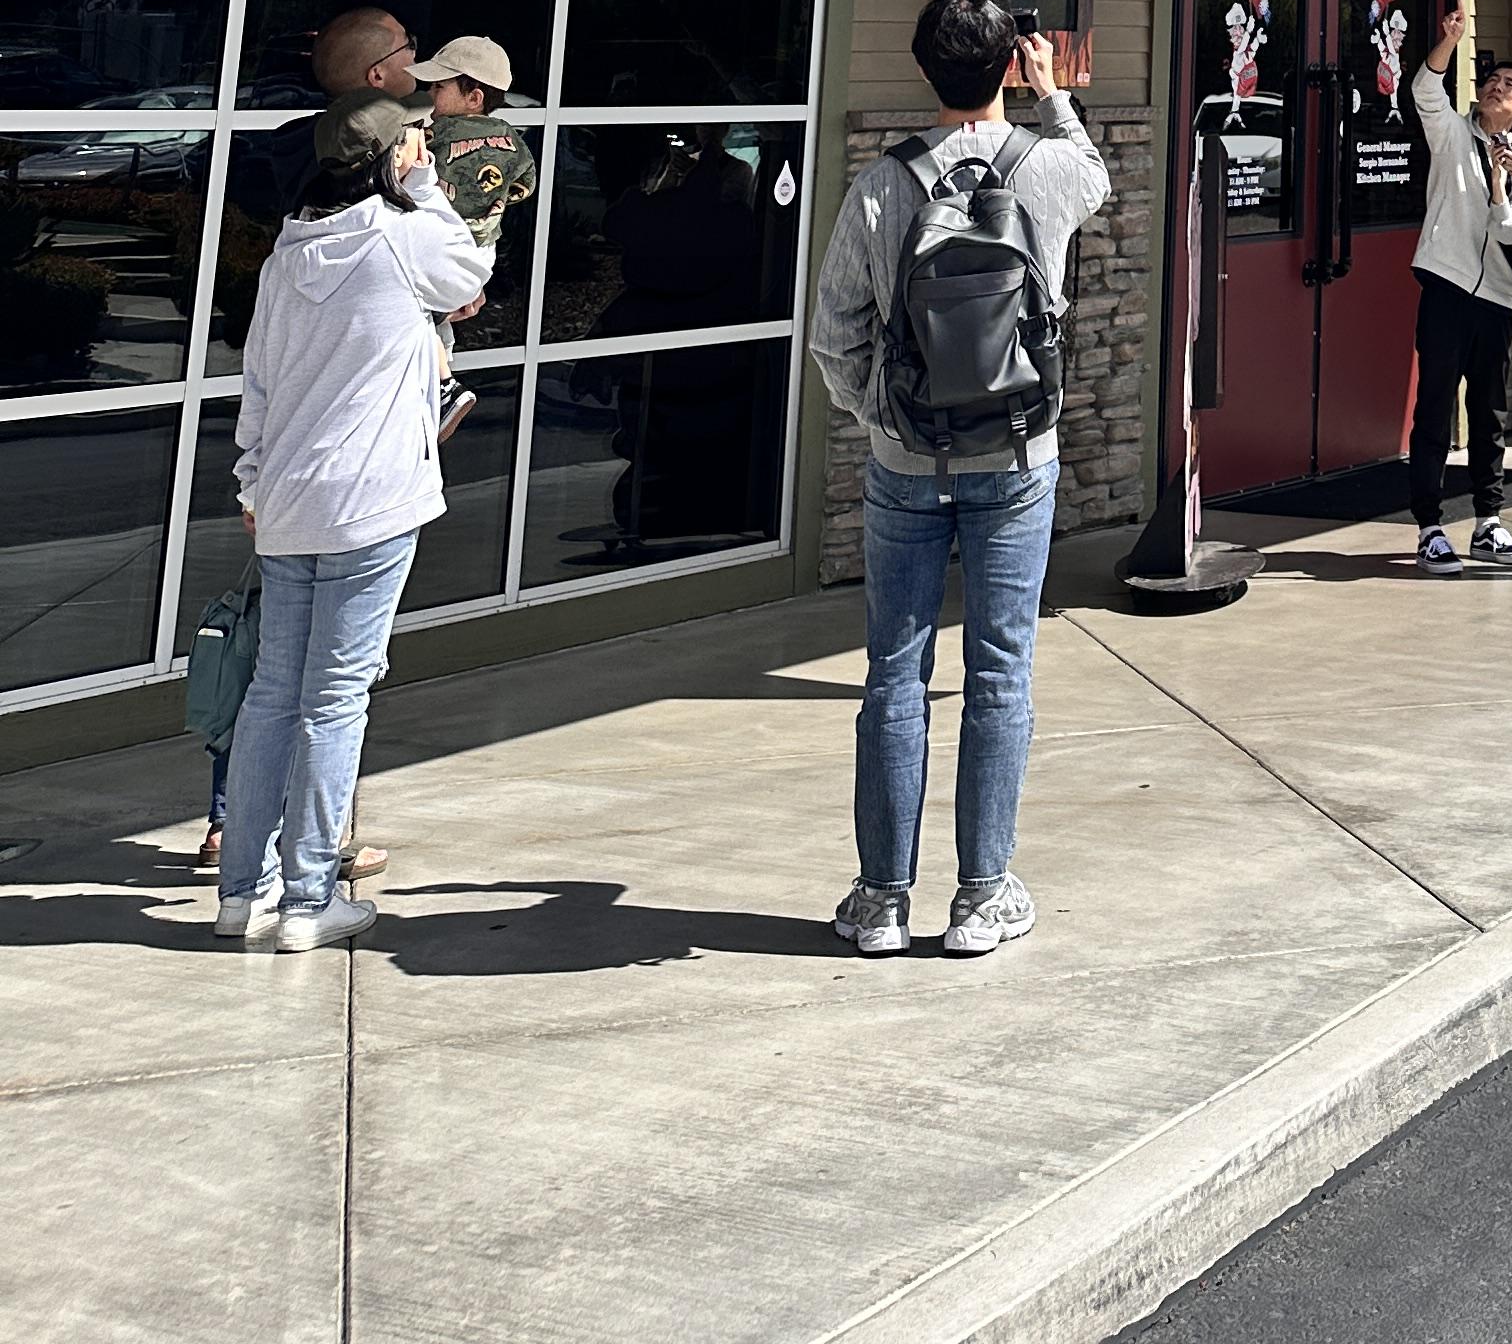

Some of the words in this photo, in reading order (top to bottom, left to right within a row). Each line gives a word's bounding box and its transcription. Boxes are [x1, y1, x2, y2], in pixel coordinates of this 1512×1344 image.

[1356, 142, 1382, 153] General
[1383, 141, 1411, 154] Manager
[1356, 172, 1381, 184] Kitchen
[1382, 171, 1411, 184] Manager
